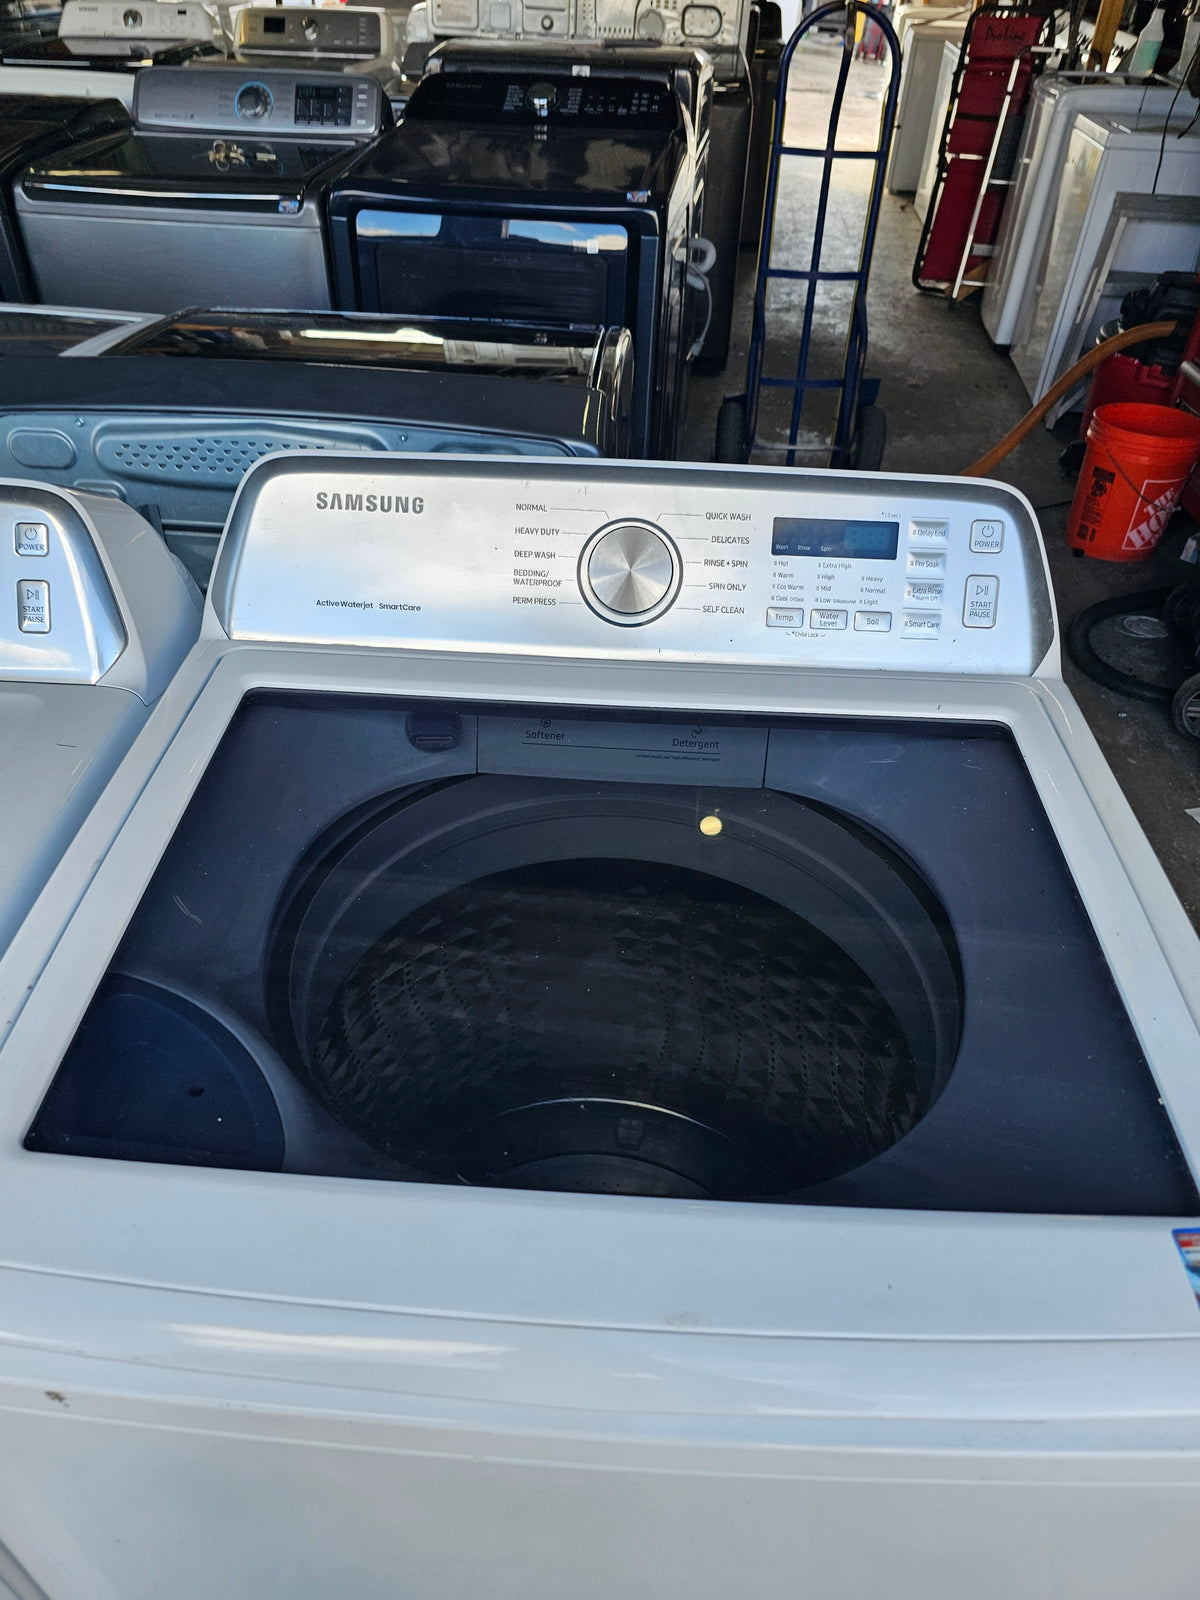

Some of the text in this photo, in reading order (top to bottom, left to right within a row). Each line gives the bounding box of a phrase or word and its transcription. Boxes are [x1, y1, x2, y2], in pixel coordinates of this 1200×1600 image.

[316, 492, 424, 514] SAMSUNG
[515, 503, 548, 512] NORMAL
[705, 512, 751, 521] QUICK WASH
[514, 527, 560, 536] HEAVY DUTY
[917, 529, 934, 537] Delay
[711, 535, 750, 545] DELICATES
[974, 540, 1000, 548] POWER
[18, 543, 45, 551] POWER
[514, 550, 556, 560] DEEP WASH
[704, 558, 725, 568] RINSE
[731, 560, 749, 568] SPIN
[513, 568, 550, 578] BEDDING/
[513, 578, 563, 587] WATERPROOF
[708, 582, 747, 592] SPIN ONLY
[512, 596, 556, 606] PERM PRESS
[378, 602, 421, 611] SmartCare
[702, 605, 745, 614] SELF CLEAN
[22, 615, 45, 623] PAUSE
[775, 613, 796, 622] Temp.
[525, 729, 565, 741] Softener
[672, 738, 719, 749] Detergent
